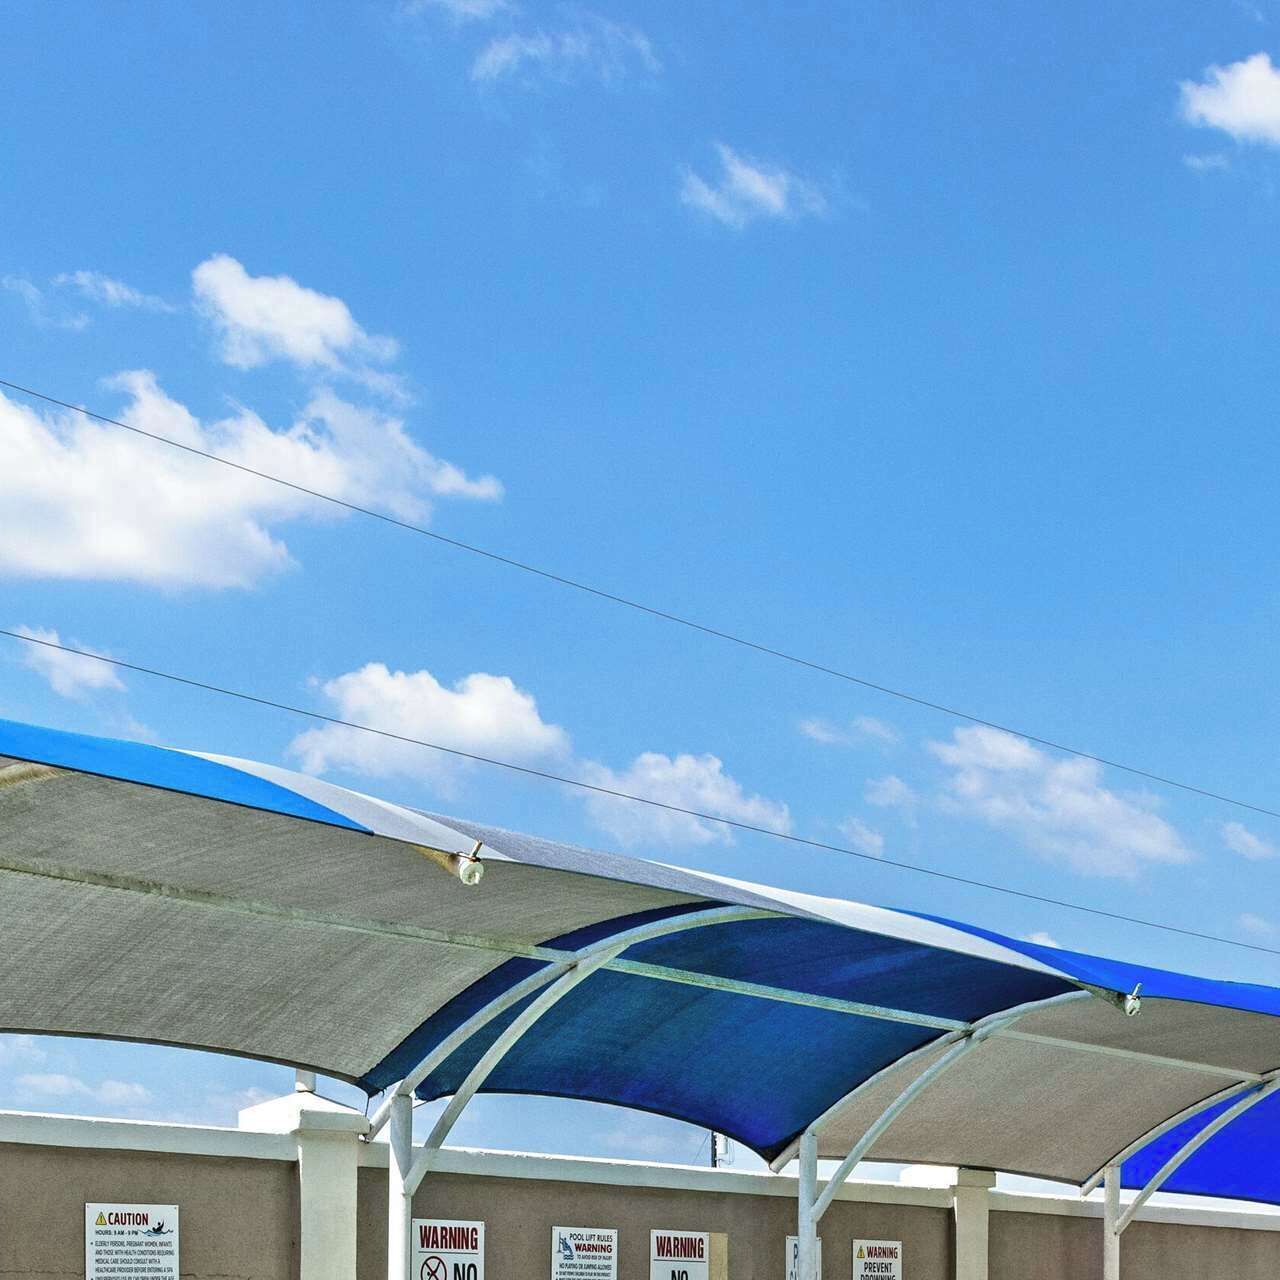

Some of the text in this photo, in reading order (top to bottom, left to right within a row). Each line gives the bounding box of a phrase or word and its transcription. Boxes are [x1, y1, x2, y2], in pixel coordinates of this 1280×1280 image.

[108, 1213, 148, 1225] CAUTION
[420, 1225, 478, 1250] WARNING
[570, 1233, 584, 1241] POOL
[586, 1233, 595, 1241] LIFT
[575, 1243, 612, 1253] WARNING
[656, 1236, 704, 1258] WARNING
[867, 1246, 898, 1259] WARNING
[864, 1262, 892, 1273] PREVENT
